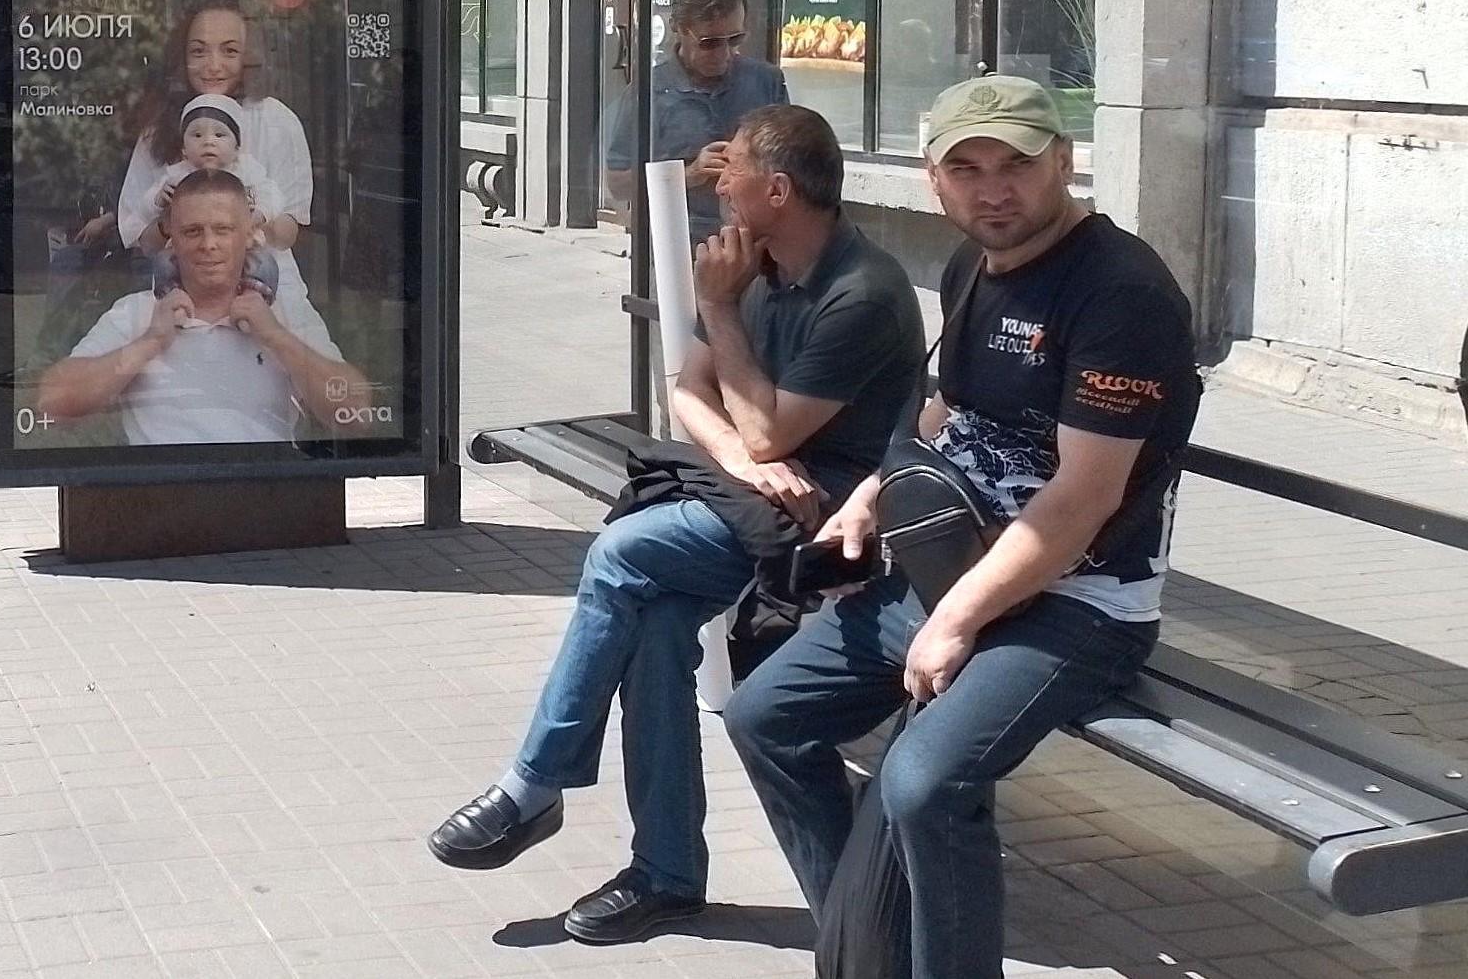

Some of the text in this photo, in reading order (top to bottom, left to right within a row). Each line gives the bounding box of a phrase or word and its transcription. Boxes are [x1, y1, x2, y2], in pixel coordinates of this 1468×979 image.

[18, 14, 133, 39] 6 ИЮЛЯ
[19, 47, 82, 70] 13:00
[20, 85, 59, 100] парк
[20, 101, 114, 116] Малиновка
[17, 408, 54, 433] 0+
